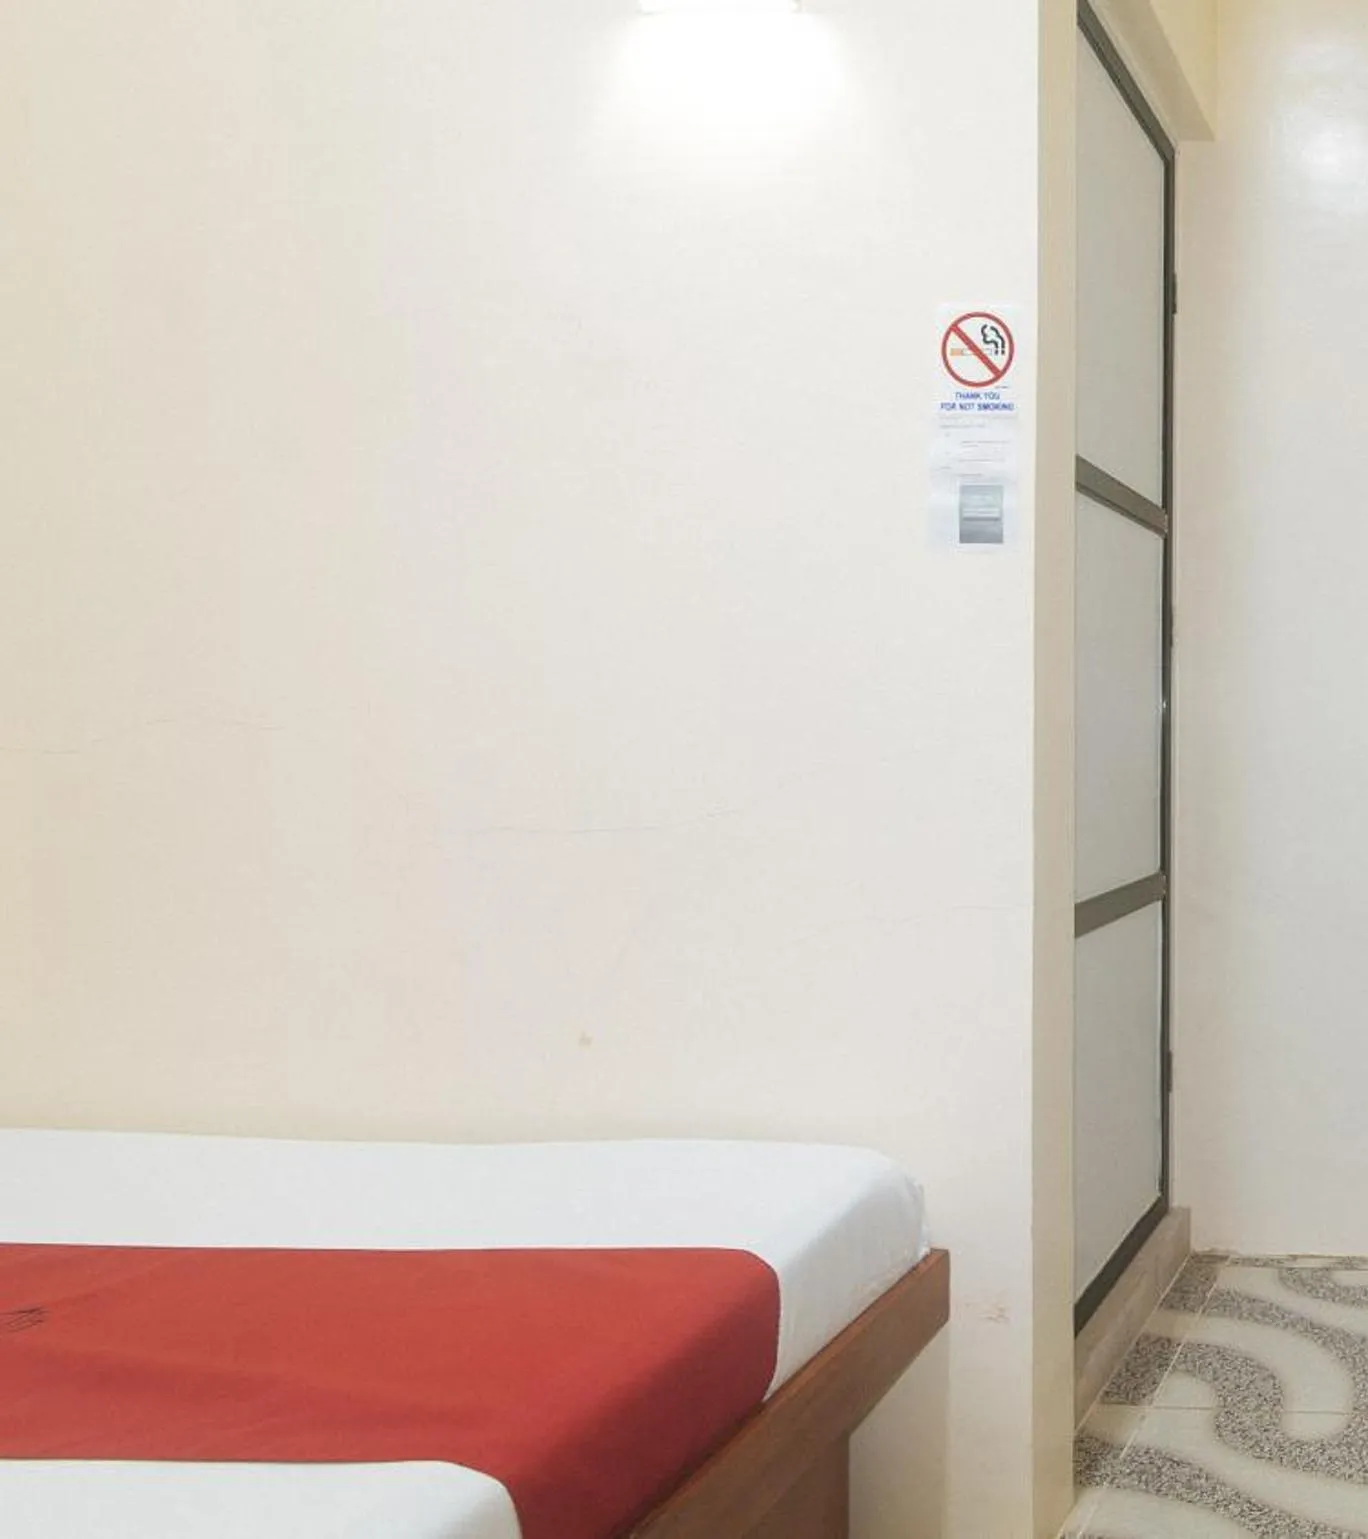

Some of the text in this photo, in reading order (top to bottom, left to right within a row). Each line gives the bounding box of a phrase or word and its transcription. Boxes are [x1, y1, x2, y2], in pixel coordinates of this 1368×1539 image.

[955, 391, 1000, 400] THANK YOU
[940, 402, 1015, 411] FOR NOT SMOKING
